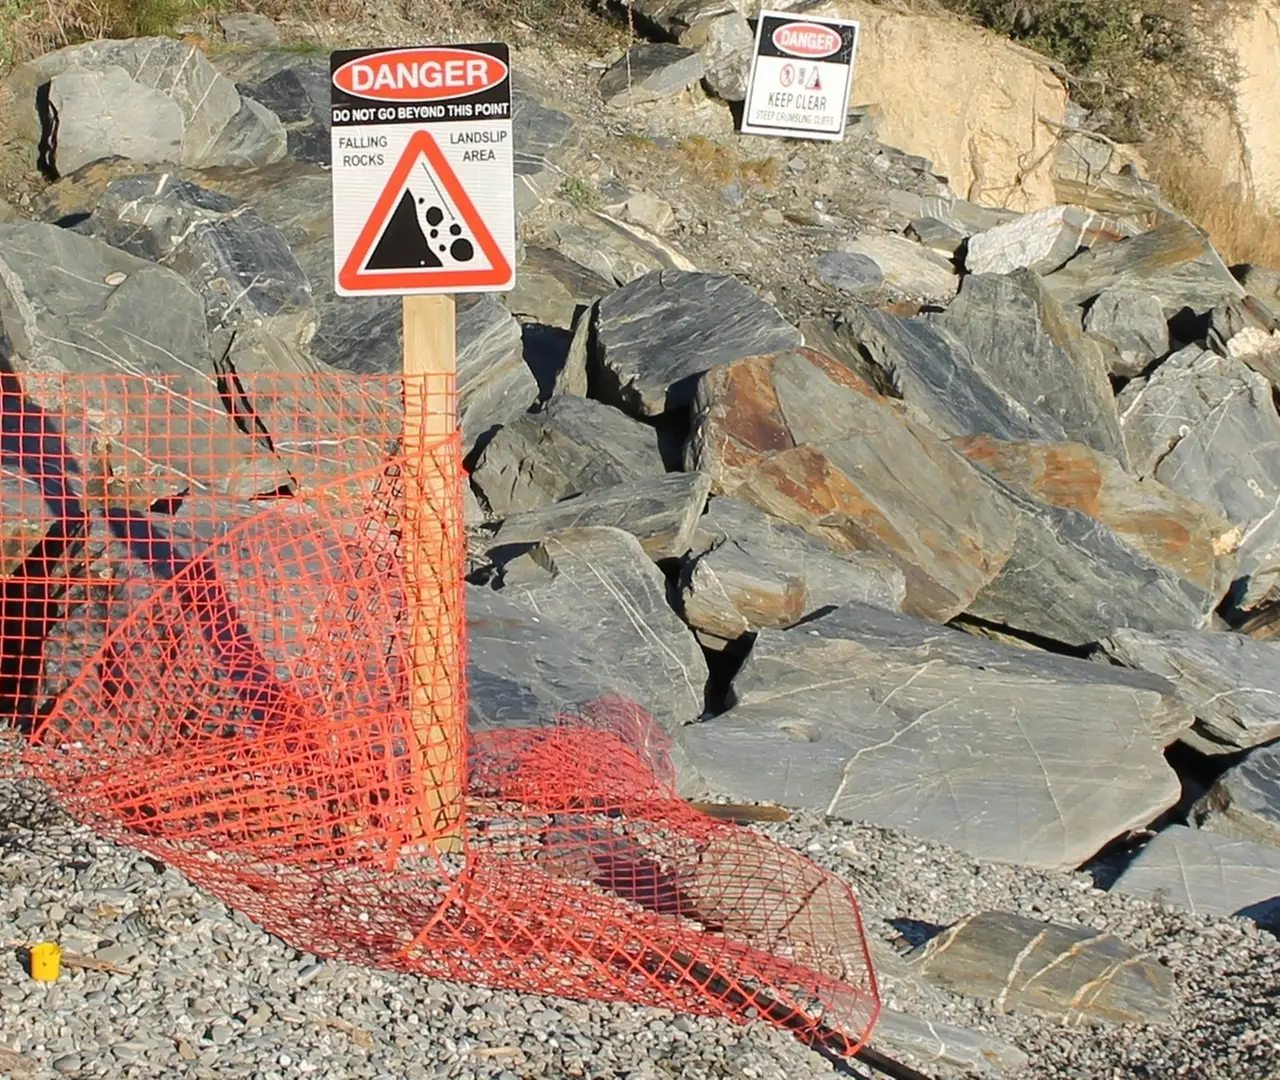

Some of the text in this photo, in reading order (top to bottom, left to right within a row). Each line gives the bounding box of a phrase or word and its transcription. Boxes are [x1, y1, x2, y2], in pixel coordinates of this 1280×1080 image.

[780, 29, 834, 50] DANGER
[351, 59, 489, 91] DANGER
[768, 92, 827, 112] KEEP CLEAR
[333, 102, 508, 122] DO NOT GO BEYOND THIS POINT
[339, 136, 387, 148] FALLING
[450, 130, 507, 145] LANDSLIP
[343, 154, 384, 167] ROCKS
[463, 150, 495, 162] AREA
